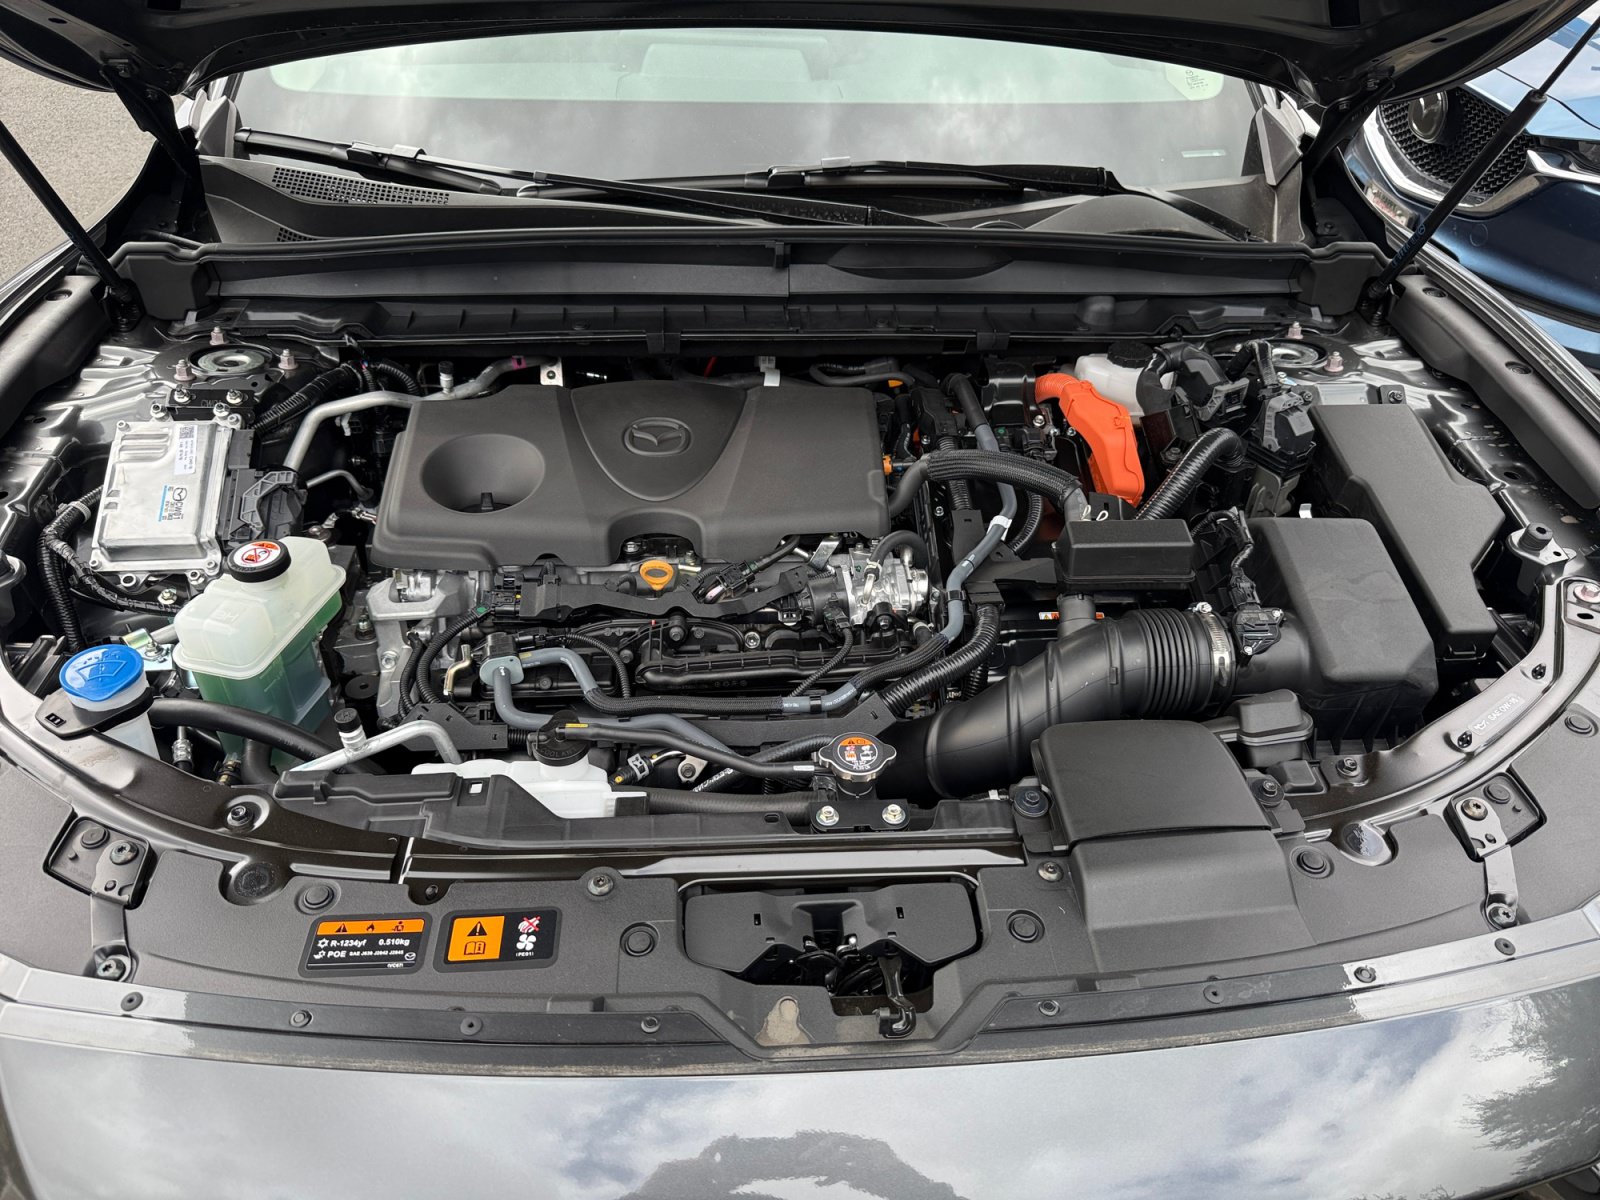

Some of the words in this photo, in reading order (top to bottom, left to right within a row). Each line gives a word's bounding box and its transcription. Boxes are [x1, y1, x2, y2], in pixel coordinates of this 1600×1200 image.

[330, 938, 367, 948] R-1234yf
[378, 938, 410, 947] 0.510kg
[327, 950, 347, 958] POE
